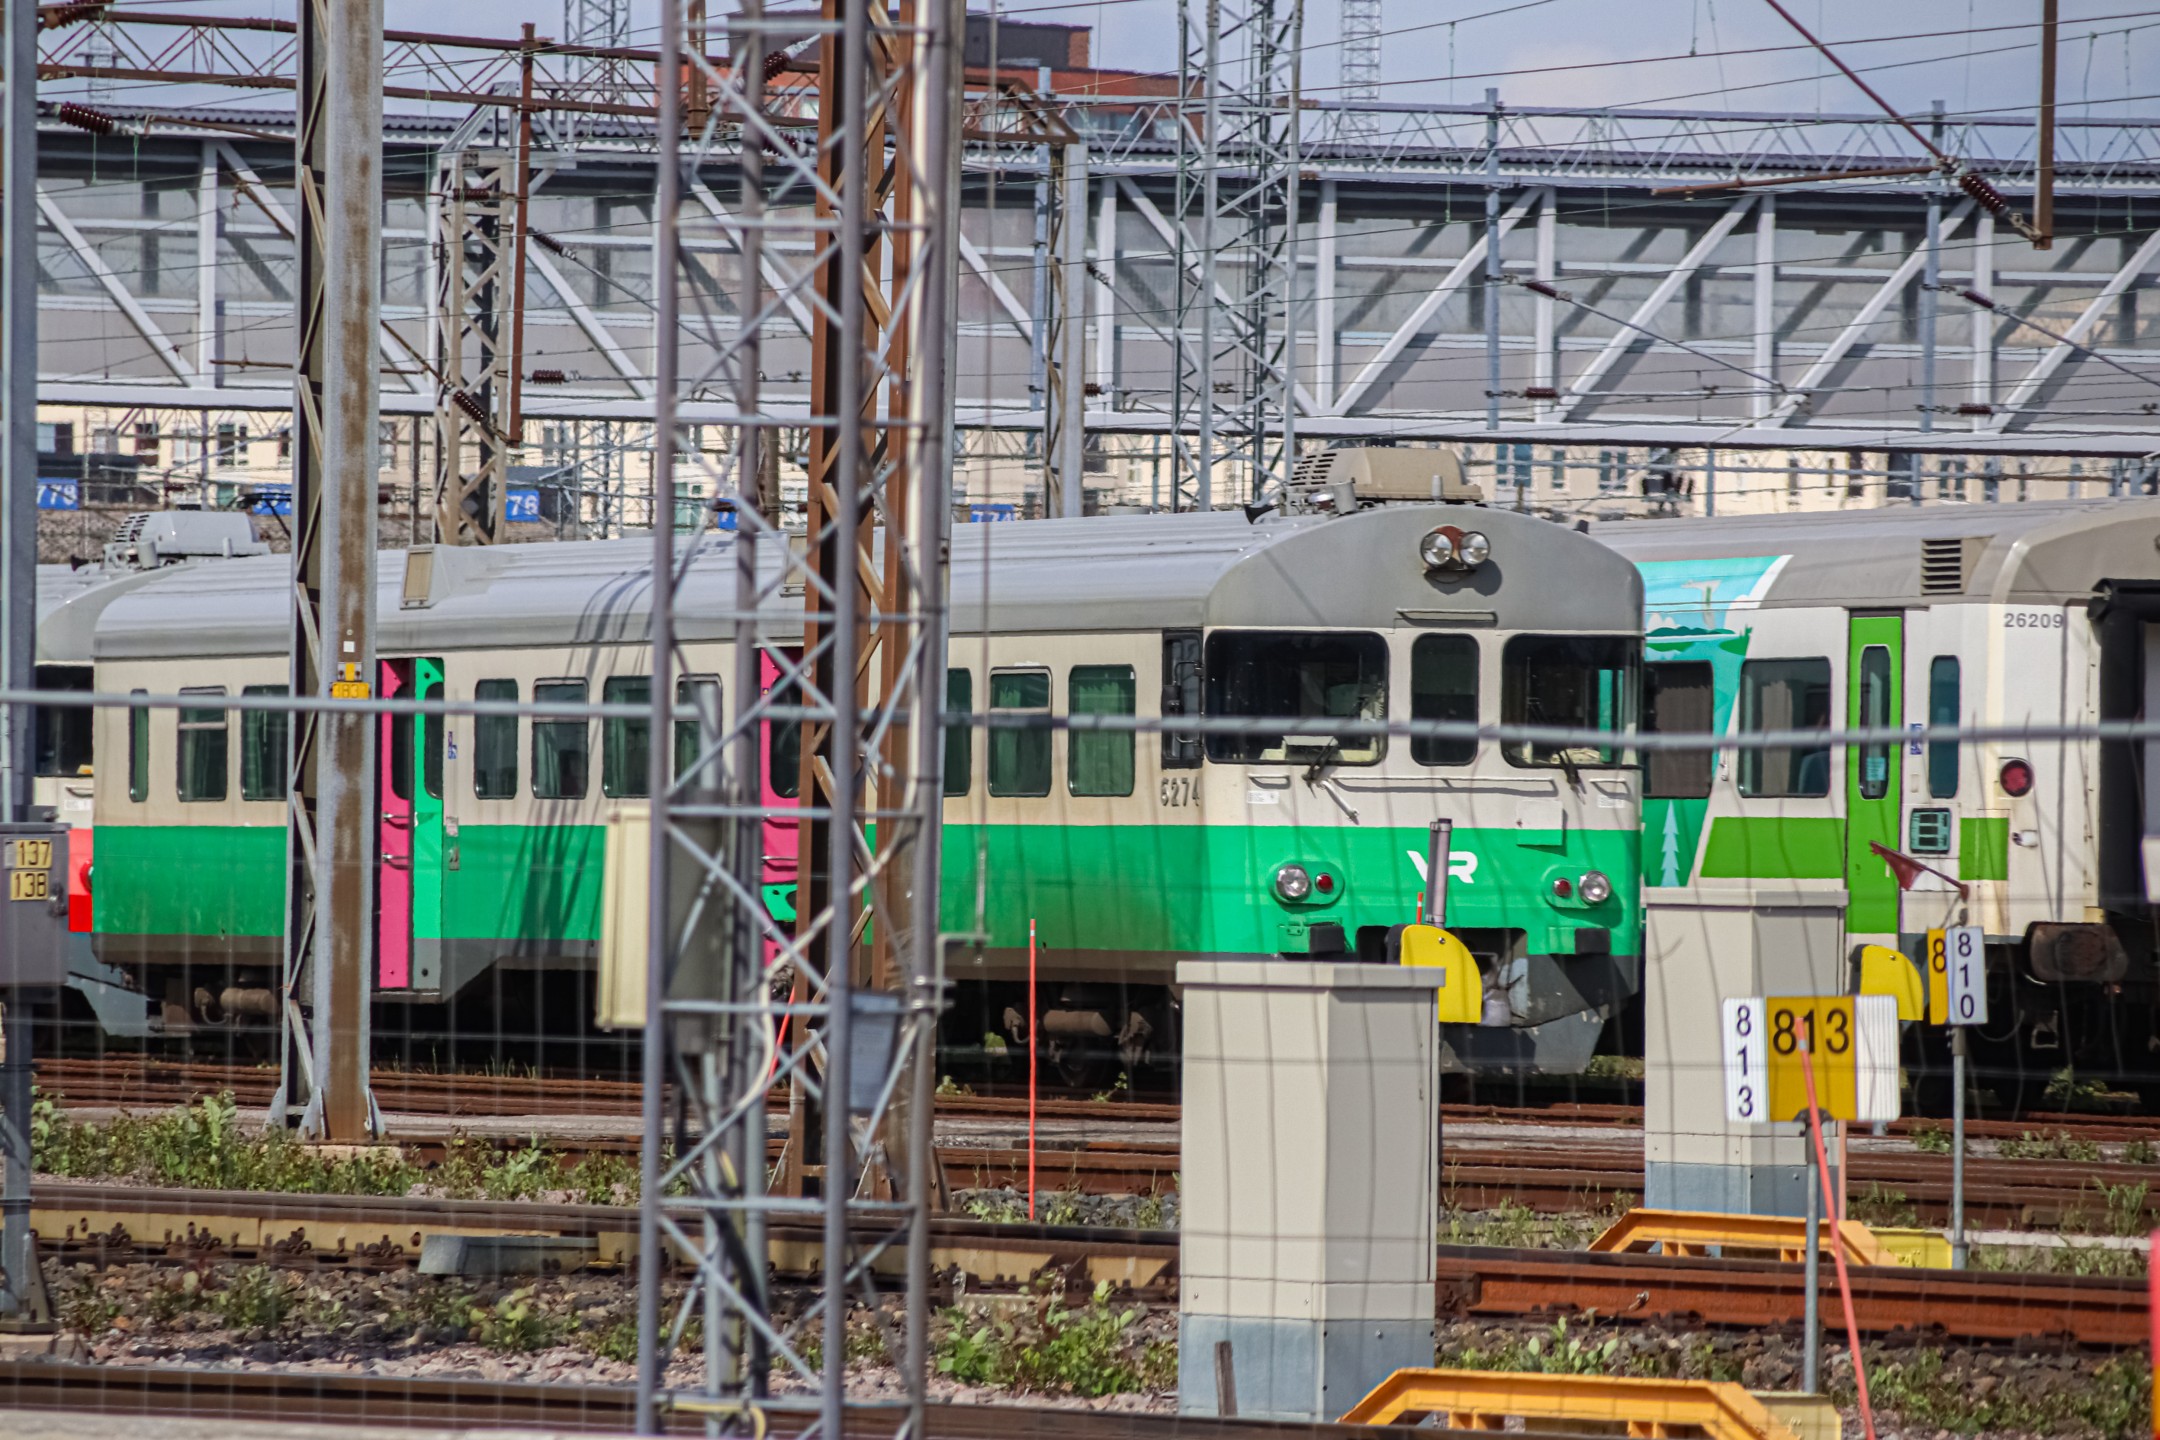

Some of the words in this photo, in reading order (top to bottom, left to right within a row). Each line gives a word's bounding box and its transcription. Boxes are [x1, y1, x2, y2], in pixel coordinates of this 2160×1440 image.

[506, 495, 538, 516] 76
[2003, 612, 2064, 629] 26209
[19, 840, 51, 866] 137
[1406, 850, 1478, 884] VR
[15, 872, 47, 898] 138
[1958, 932, 1975, 1019] 810
[1772, 1008, 1850, 1056] 813
[1736, 1004, 1753, 1118] 813
